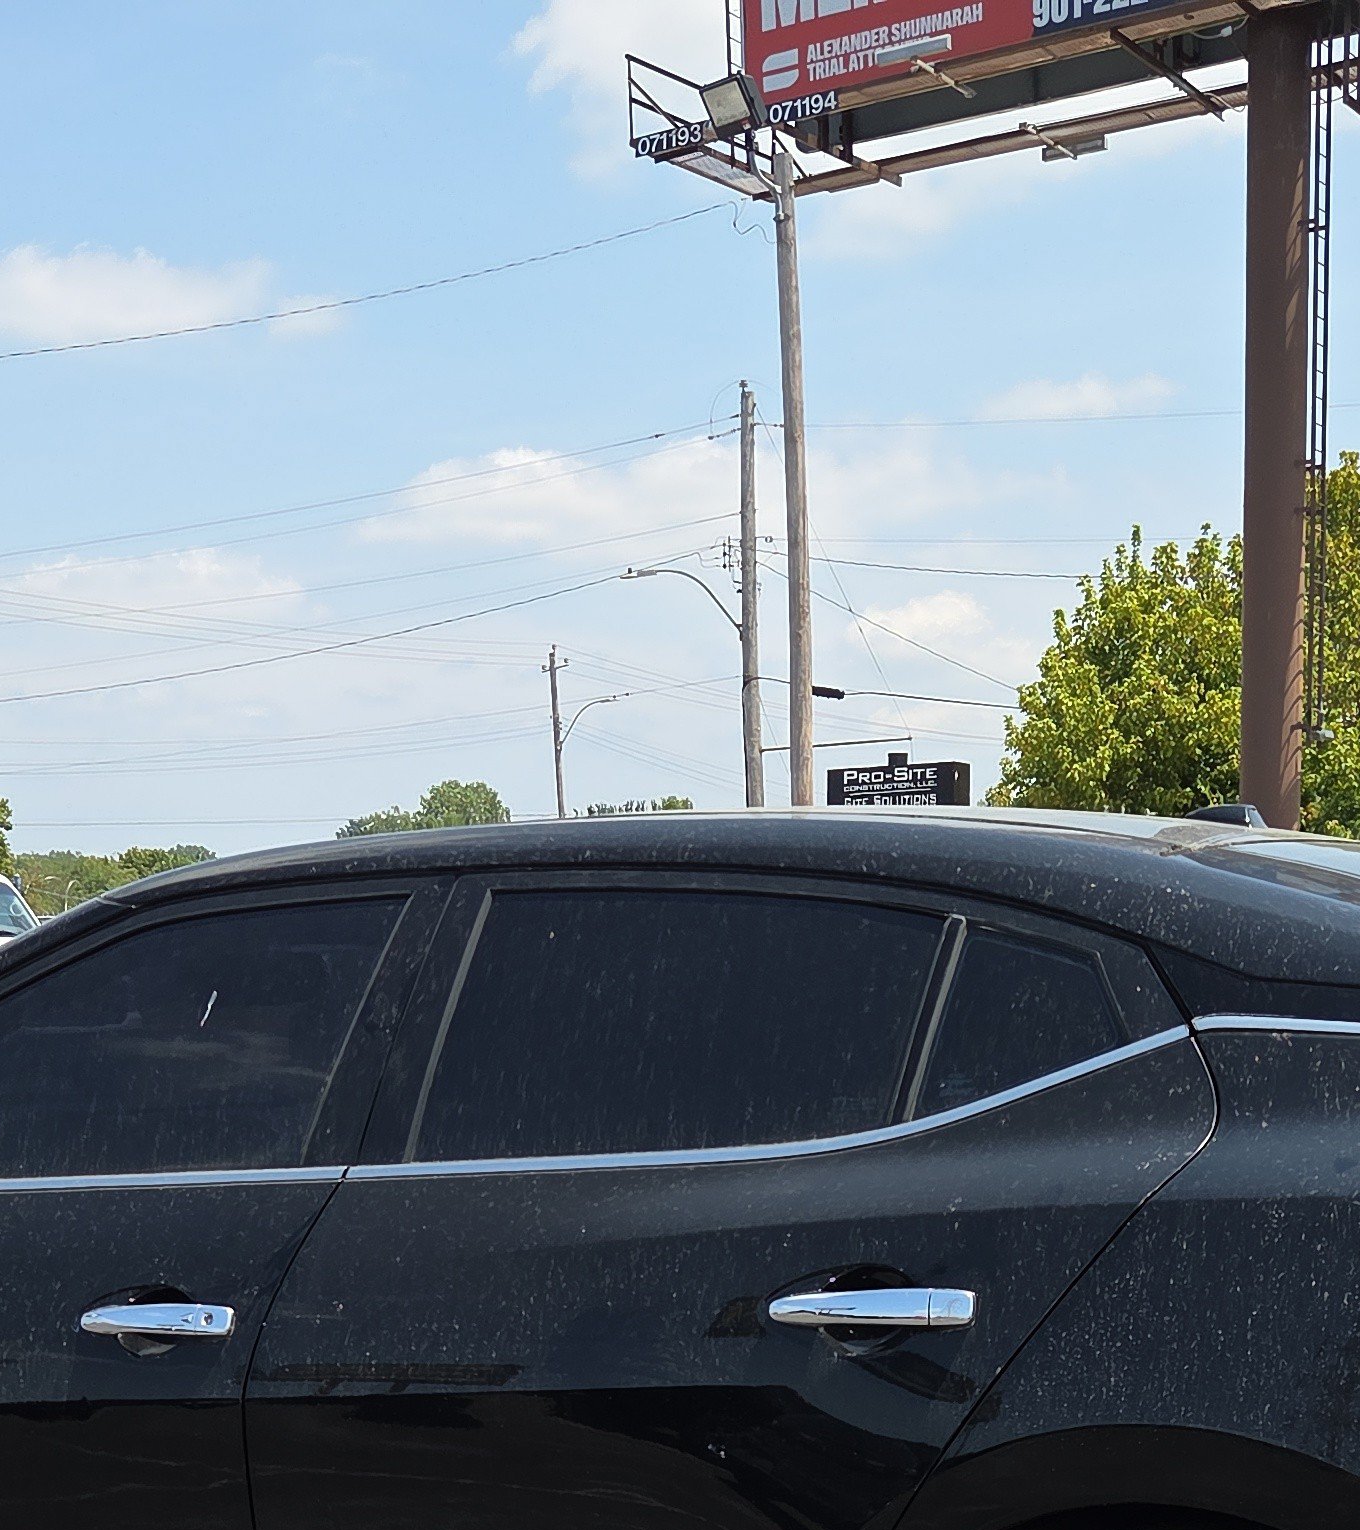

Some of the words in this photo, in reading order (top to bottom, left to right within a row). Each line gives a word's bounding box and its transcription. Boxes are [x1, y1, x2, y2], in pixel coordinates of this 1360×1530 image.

[807, 26, 889, 63] ALEXANDER
[891, 2, 984, 42] SHUNNARAH
[807, 55, 848, 82] TRIAL
[769, 90, 838, 124] 071194
[637, 122, 702, 156] 071193
